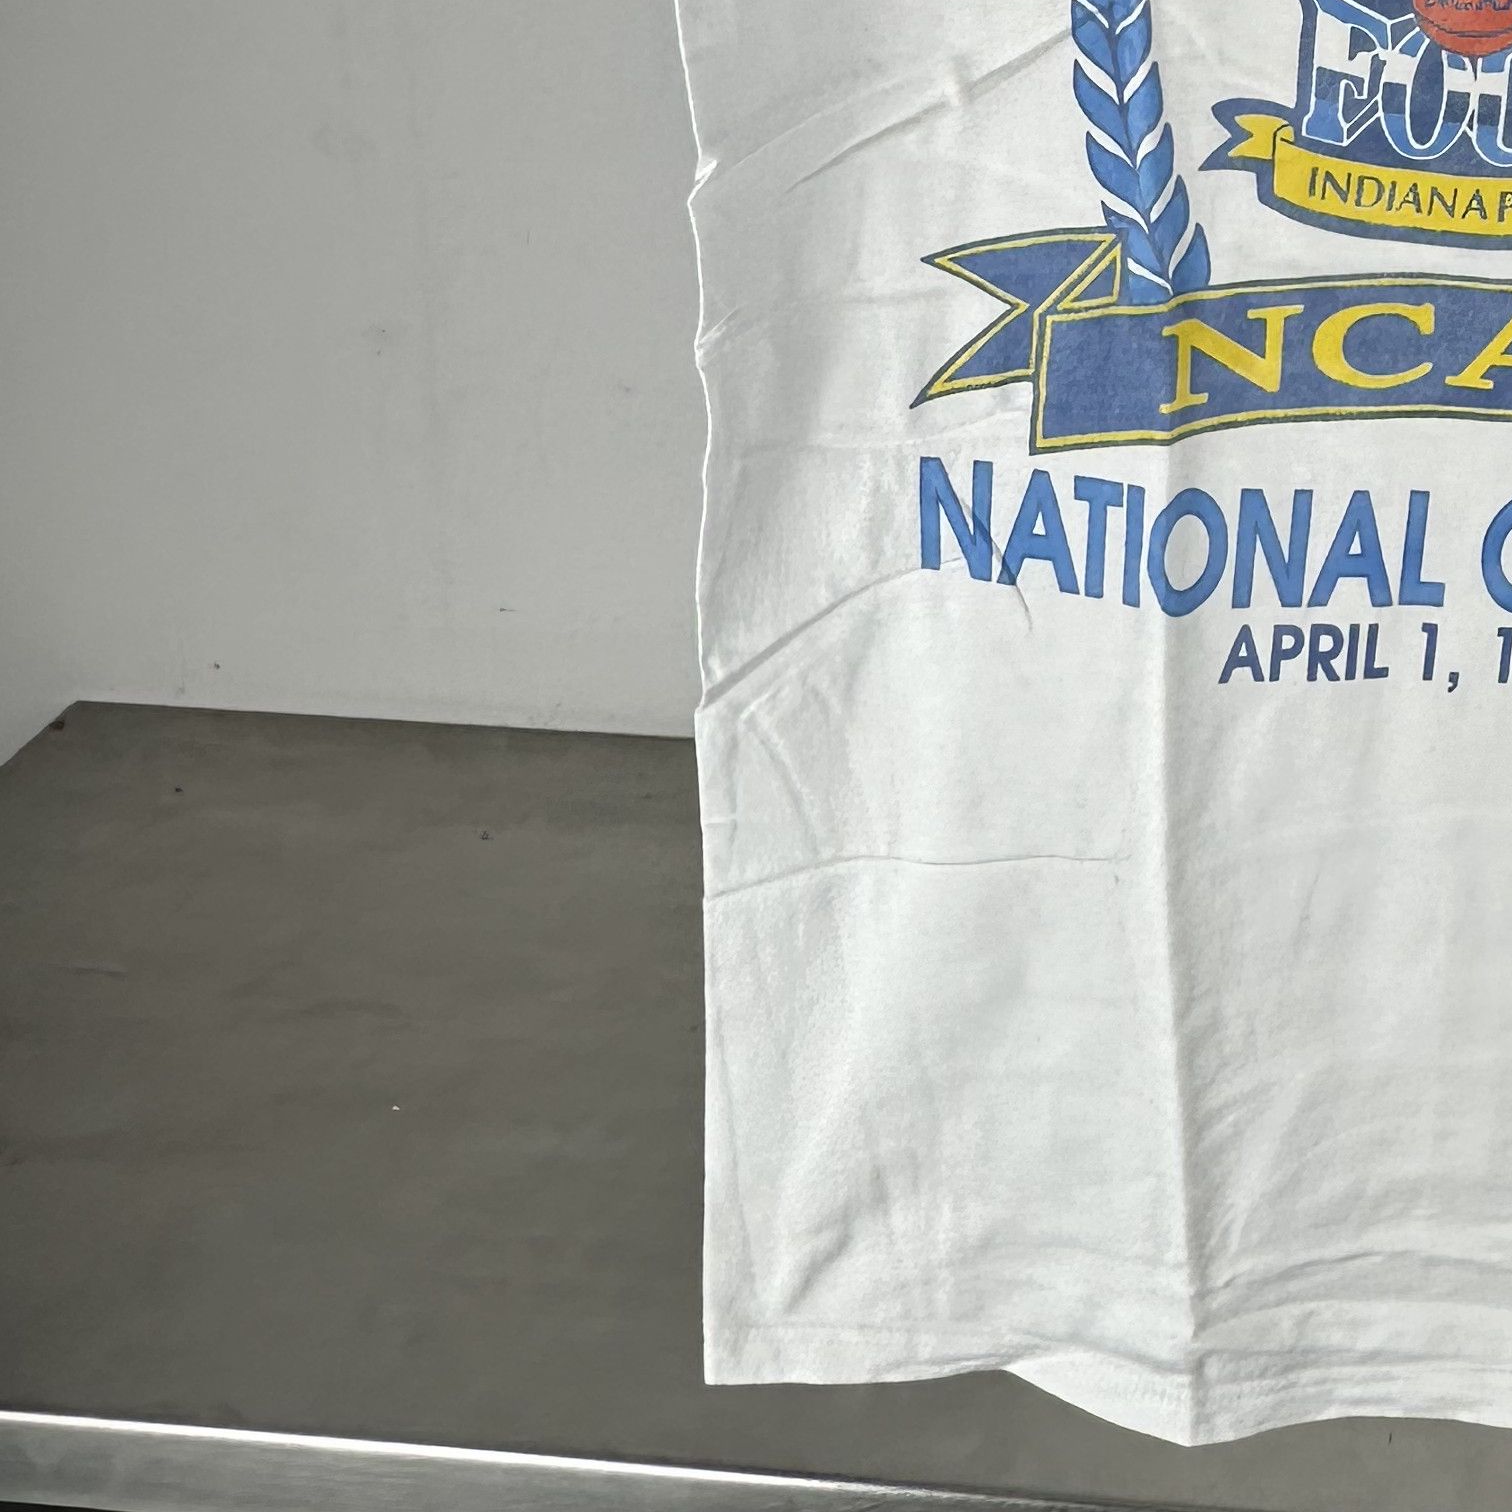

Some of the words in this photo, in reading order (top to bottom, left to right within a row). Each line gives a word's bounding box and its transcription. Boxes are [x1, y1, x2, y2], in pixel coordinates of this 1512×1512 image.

[918, 455, 1445, 619] NATIONAL
[1218, 622, 1390, 686] APRIL
[1420, 628, 1460, 693] 1,
